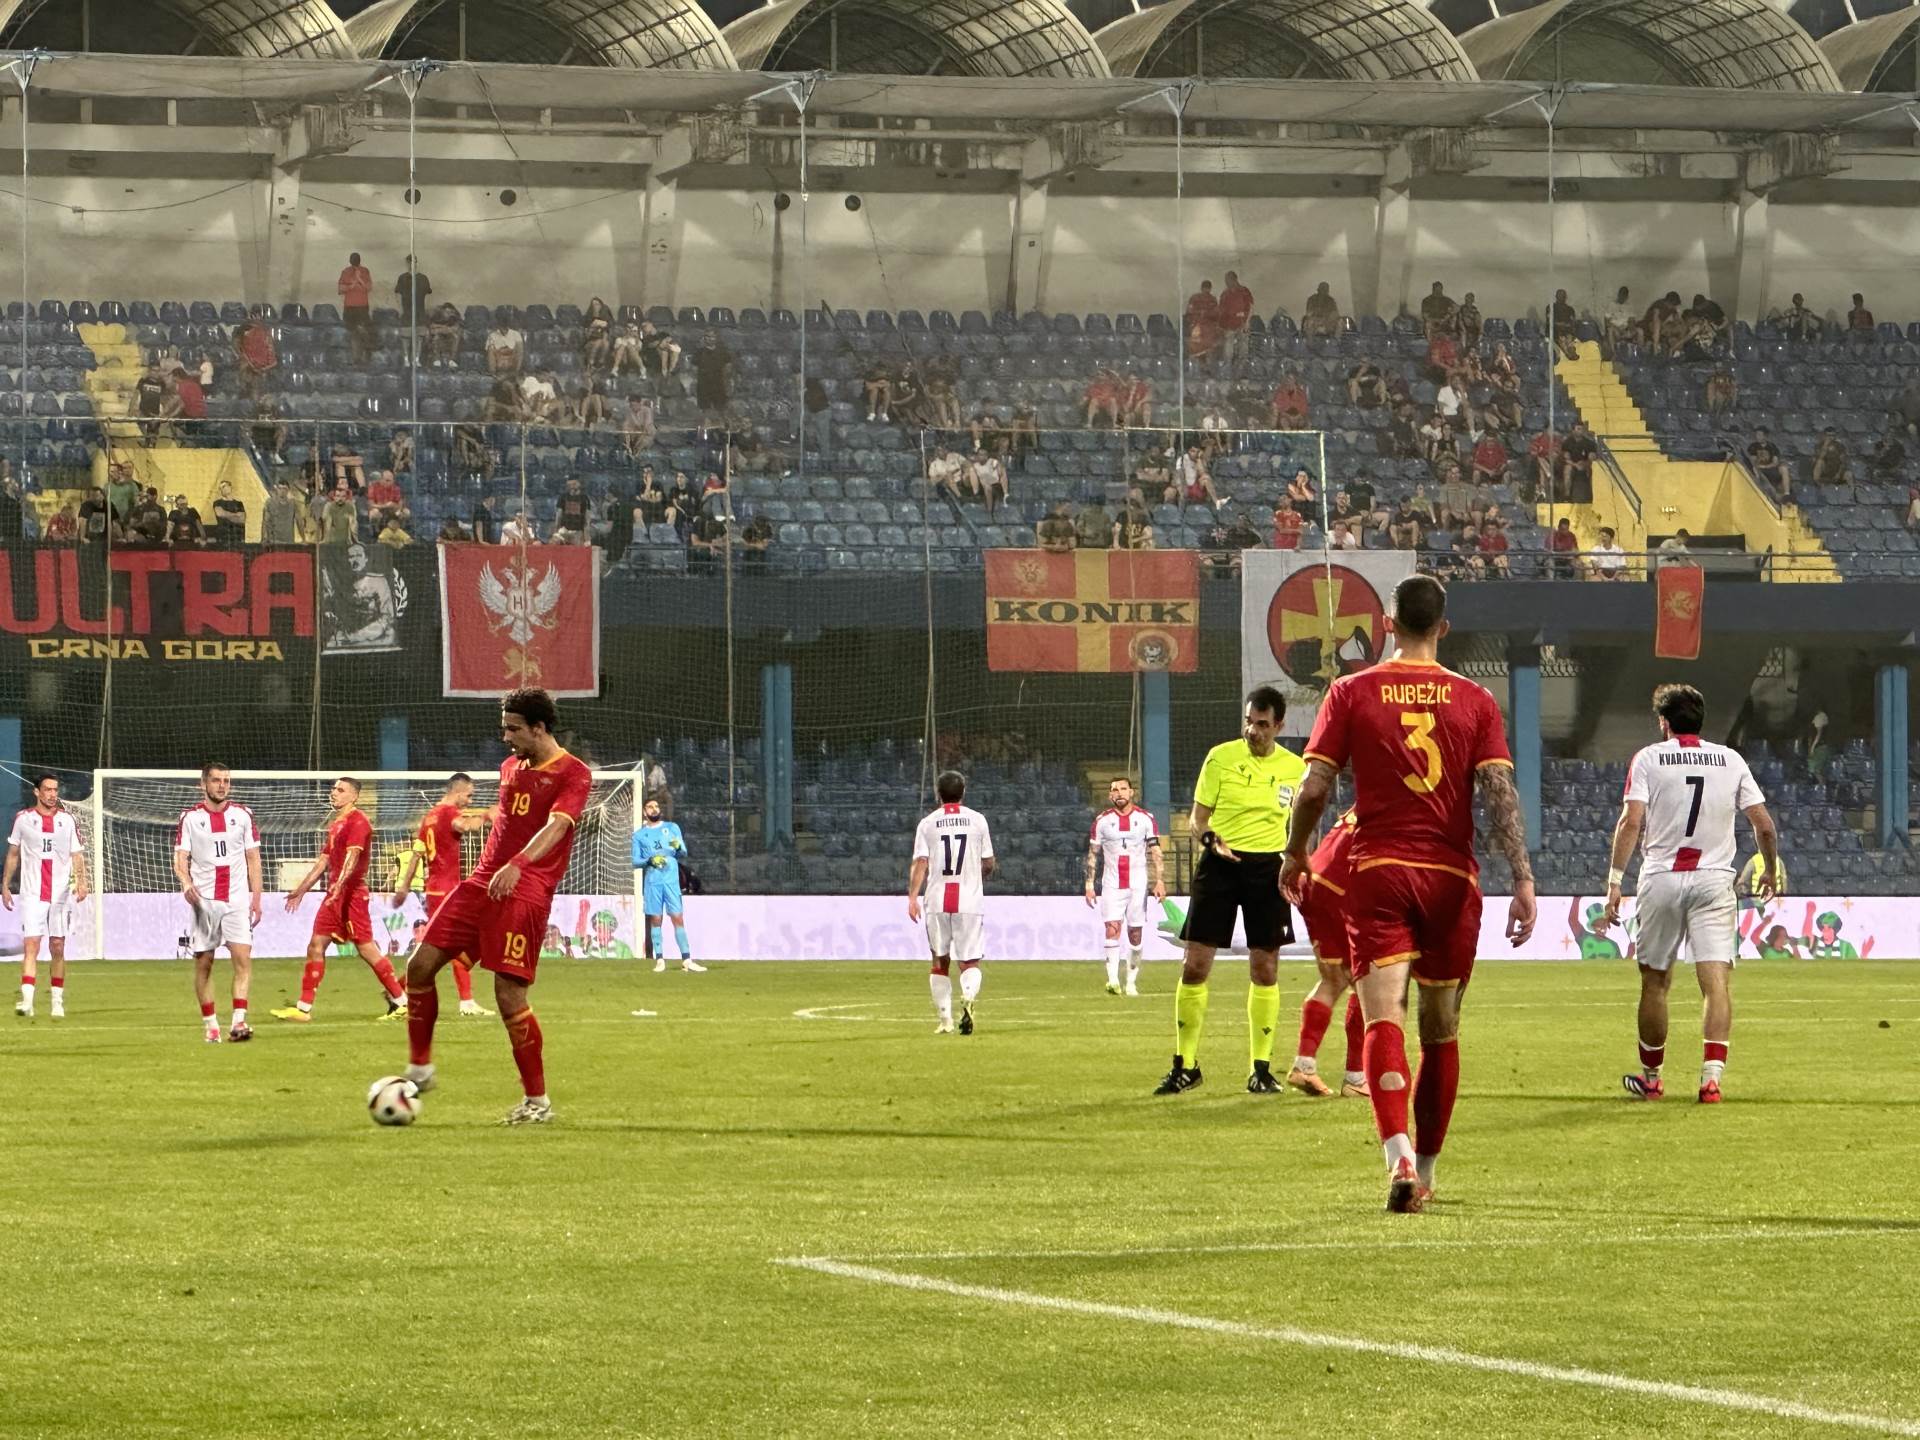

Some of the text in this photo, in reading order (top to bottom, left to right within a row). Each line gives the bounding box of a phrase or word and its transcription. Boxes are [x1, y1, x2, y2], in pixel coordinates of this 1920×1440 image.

[0, 550, 313, 636] ULTRA
[993, 600, 1191, 623] KONIK
[28, 638, 284, 661] CRNA GORA
[1381, 682, 1452, 704] RUBEŽIĆ
[1401, 712, 1442, 793] 3
[512, 792, 531, 816] 19
[1685, 775, 1705, 837] 7
[215, 840, 227, 858] 10
[941, 834, 967, 876] 17
[504, 931, 527, 960] 19
